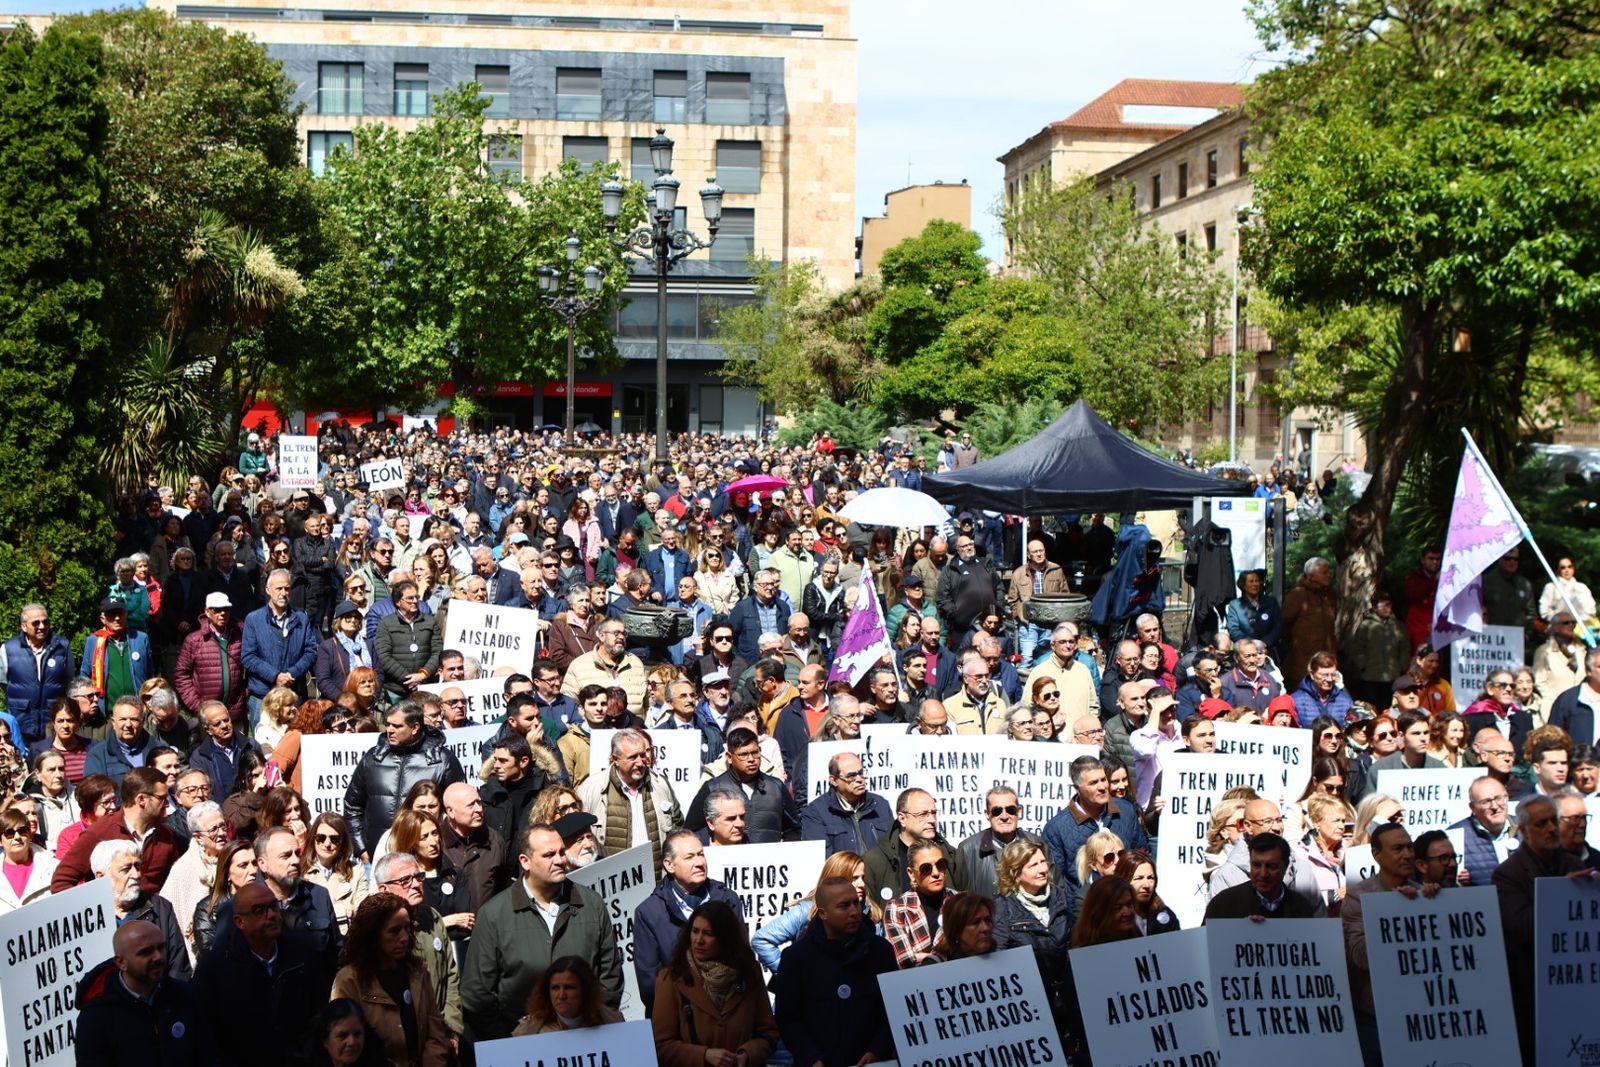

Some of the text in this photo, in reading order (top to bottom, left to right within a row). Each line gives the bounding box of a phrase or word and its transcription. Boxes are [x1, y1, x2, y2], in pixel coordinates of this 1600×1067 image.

[283, 444, 316, 453] EL TREN
[361, 463, 403, 484] LEÓN
[484, 614, 500, 630] NI
[459, 629, 521, 650] AISLADOS
[480, 650, 495, 665] NI
[914, 751, 985, 770] ALAMAN
[1000, 757, 1036, 776] TREN
[675, 768, 689, 782] DE
[894, 773, 908, 789] NO
[935, 774, 978, 793] NO ES
[1179, 772, 1217, 790] TREN
[1017, 780, 1032, 798] LA
[1402, 784, 1461, 801] RENFE YA
[1171, 796, 1212, 815] DE LA
[723, 864, 789, 891] MENOS
[1568, 899, 1584, 921] LA
[7, 904, 106, 967] SALAMANCA
[1379, 911, 1487, 944] RENFE NOS
[1551, 932, 1568, 953] DE
[1575, 930, 1591, 953] LA
[1234, 941, 1321, 969] PORTUGAL
[1397, 944, 1476, 976] DEJA EN
[36, 946, 85, 990] NO ES
[1134, 952, 1162, 984] NI
[1548, 962, 1584, 986] PARA
[904, 973, 1024, 1018] NI EXCUSAS
[1220, 971, 1341, 1001] ESTÁ AL LADO,
[1423, 973, 1460, 1007] VÍA
[1106, 981, 1209, 1026] AISLADOS
[903, 1000, 1041, 1047] NI RETRASOS:
[1226, 1004, 1345, 1037] EL TREN NO
[1405, 1008, 1488, 1043] MUERTA
[1150, 1022, 1179, 1053] NI
